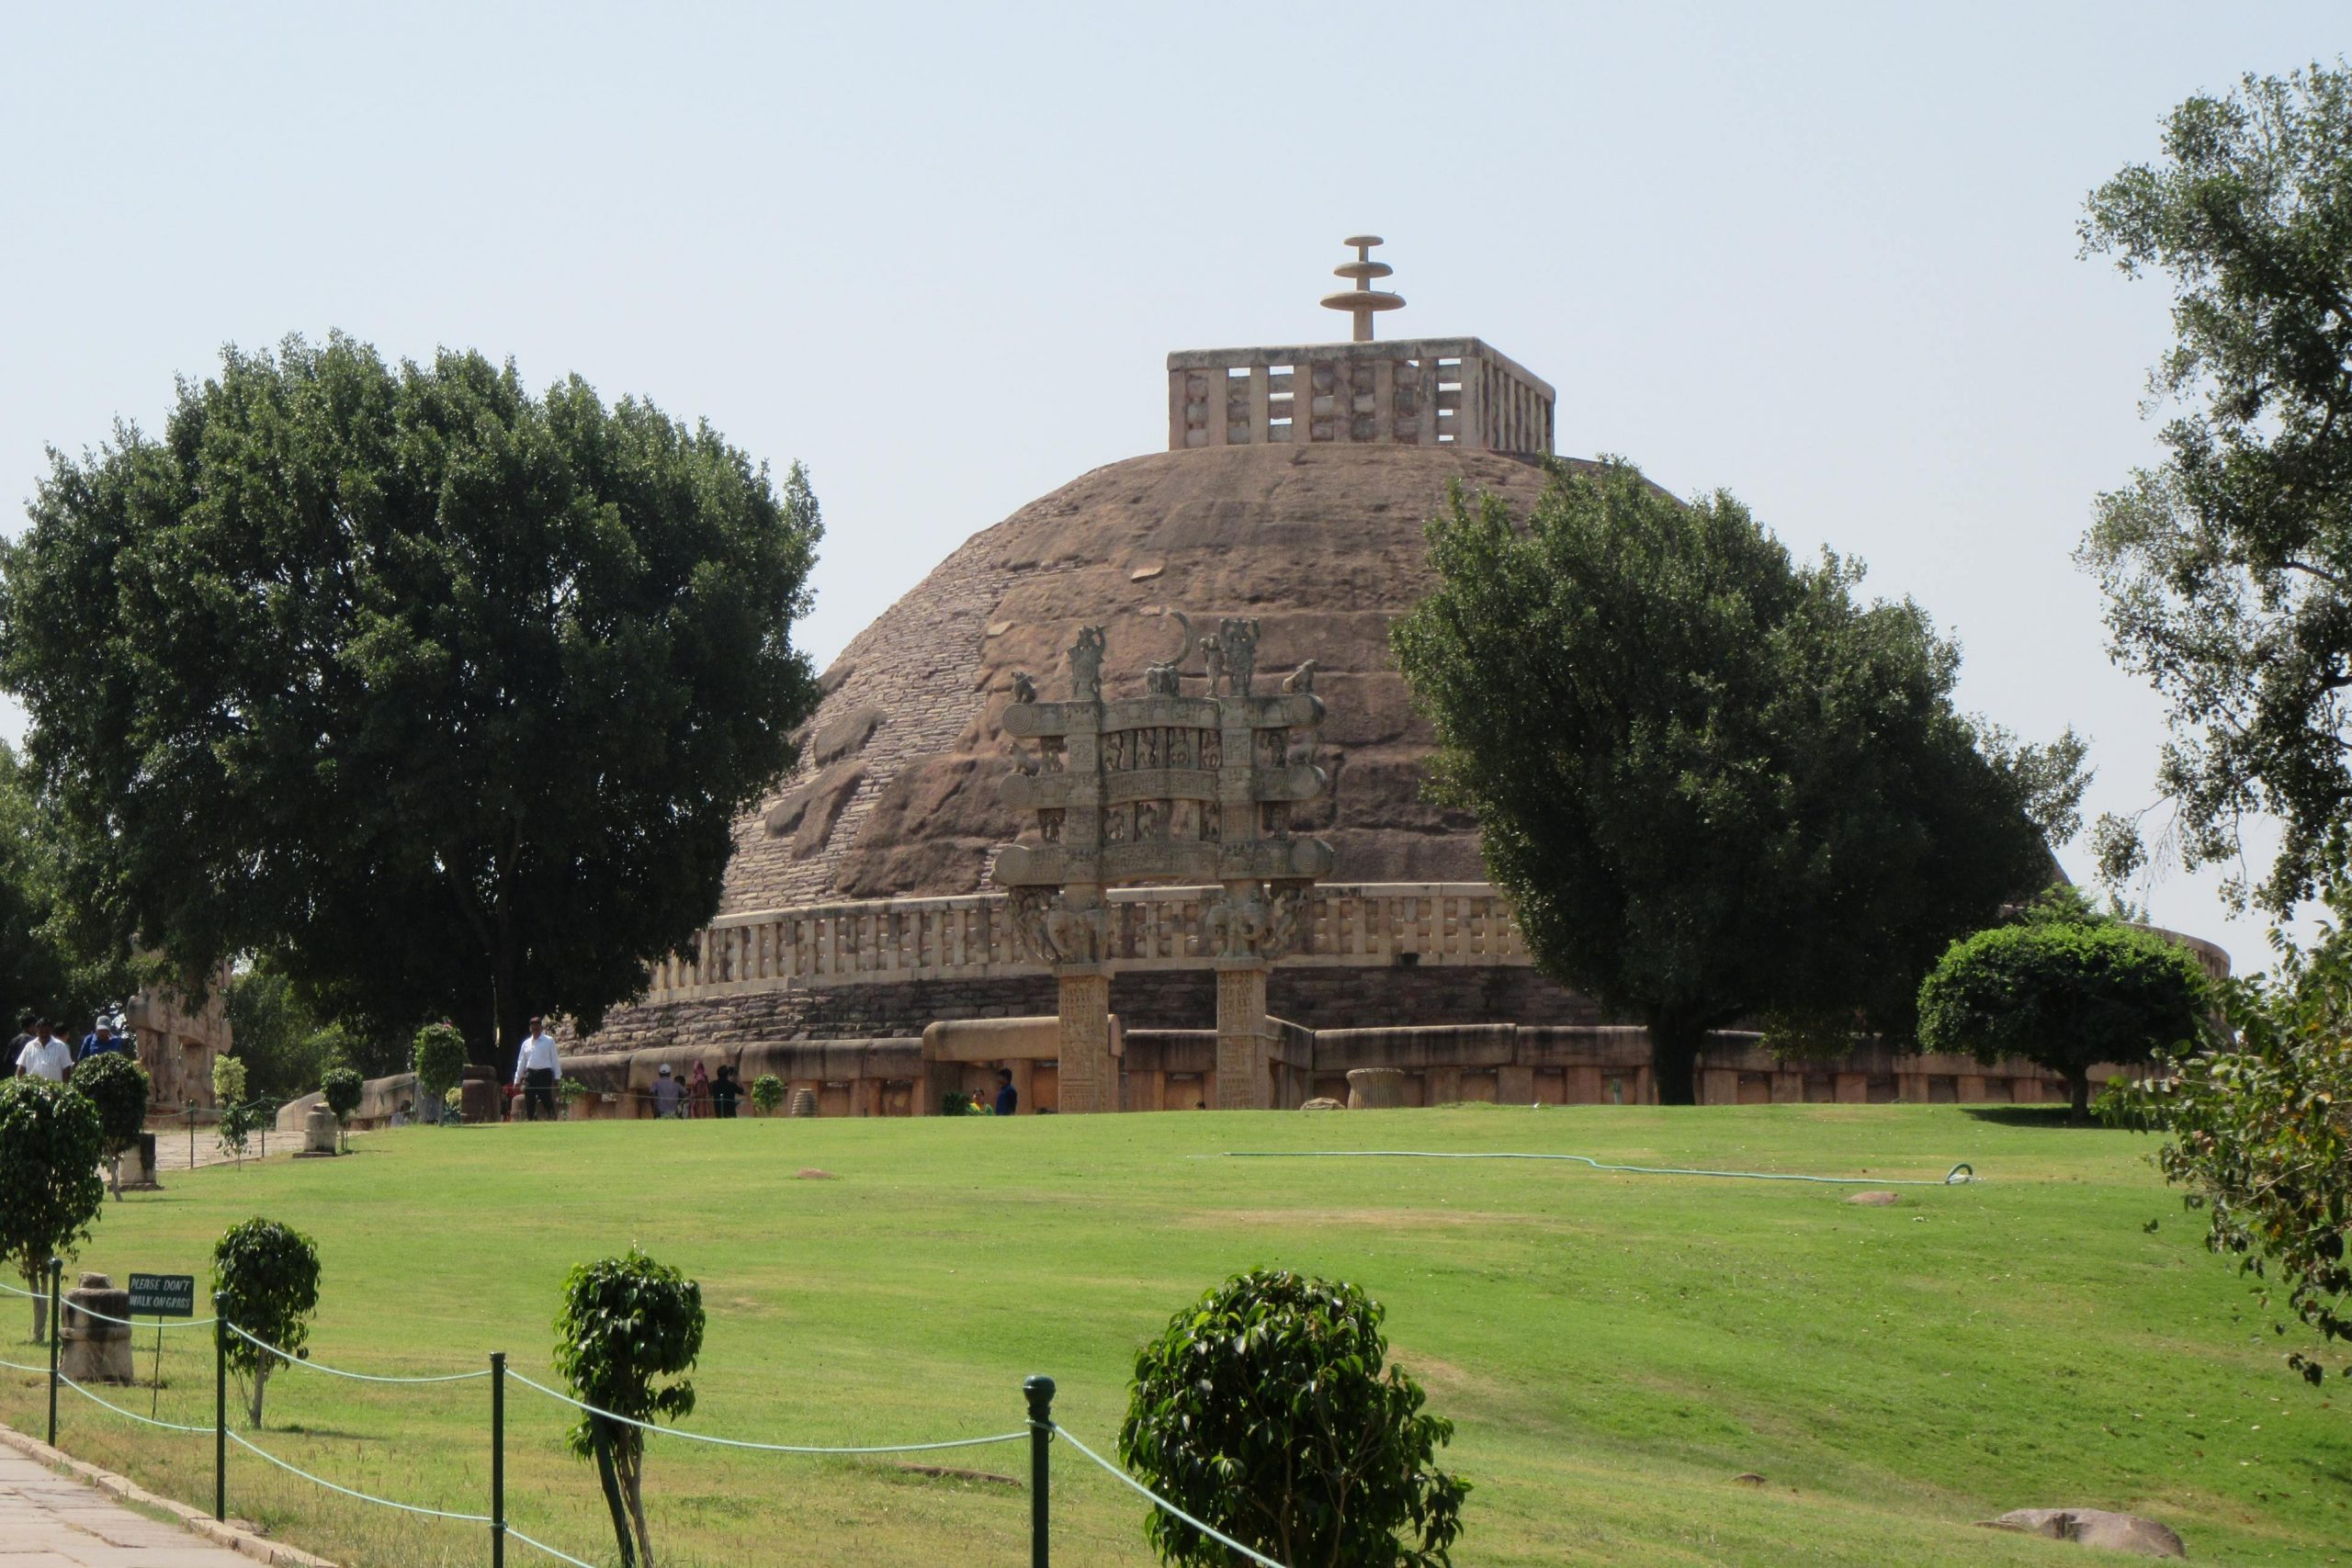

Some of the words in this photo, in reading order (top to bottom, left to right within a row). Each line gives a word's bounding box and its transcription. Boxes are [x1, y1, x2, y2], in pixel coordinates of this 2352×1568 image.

[130, 1278, 161, 1291] PLEASE
[164, 1280, 191, 1292] DON'T
[130, 1294, 152, 1307] WALK
[153, 1296, 165, 1307] ON
[166, 1296, 190, 1309] GRASS
